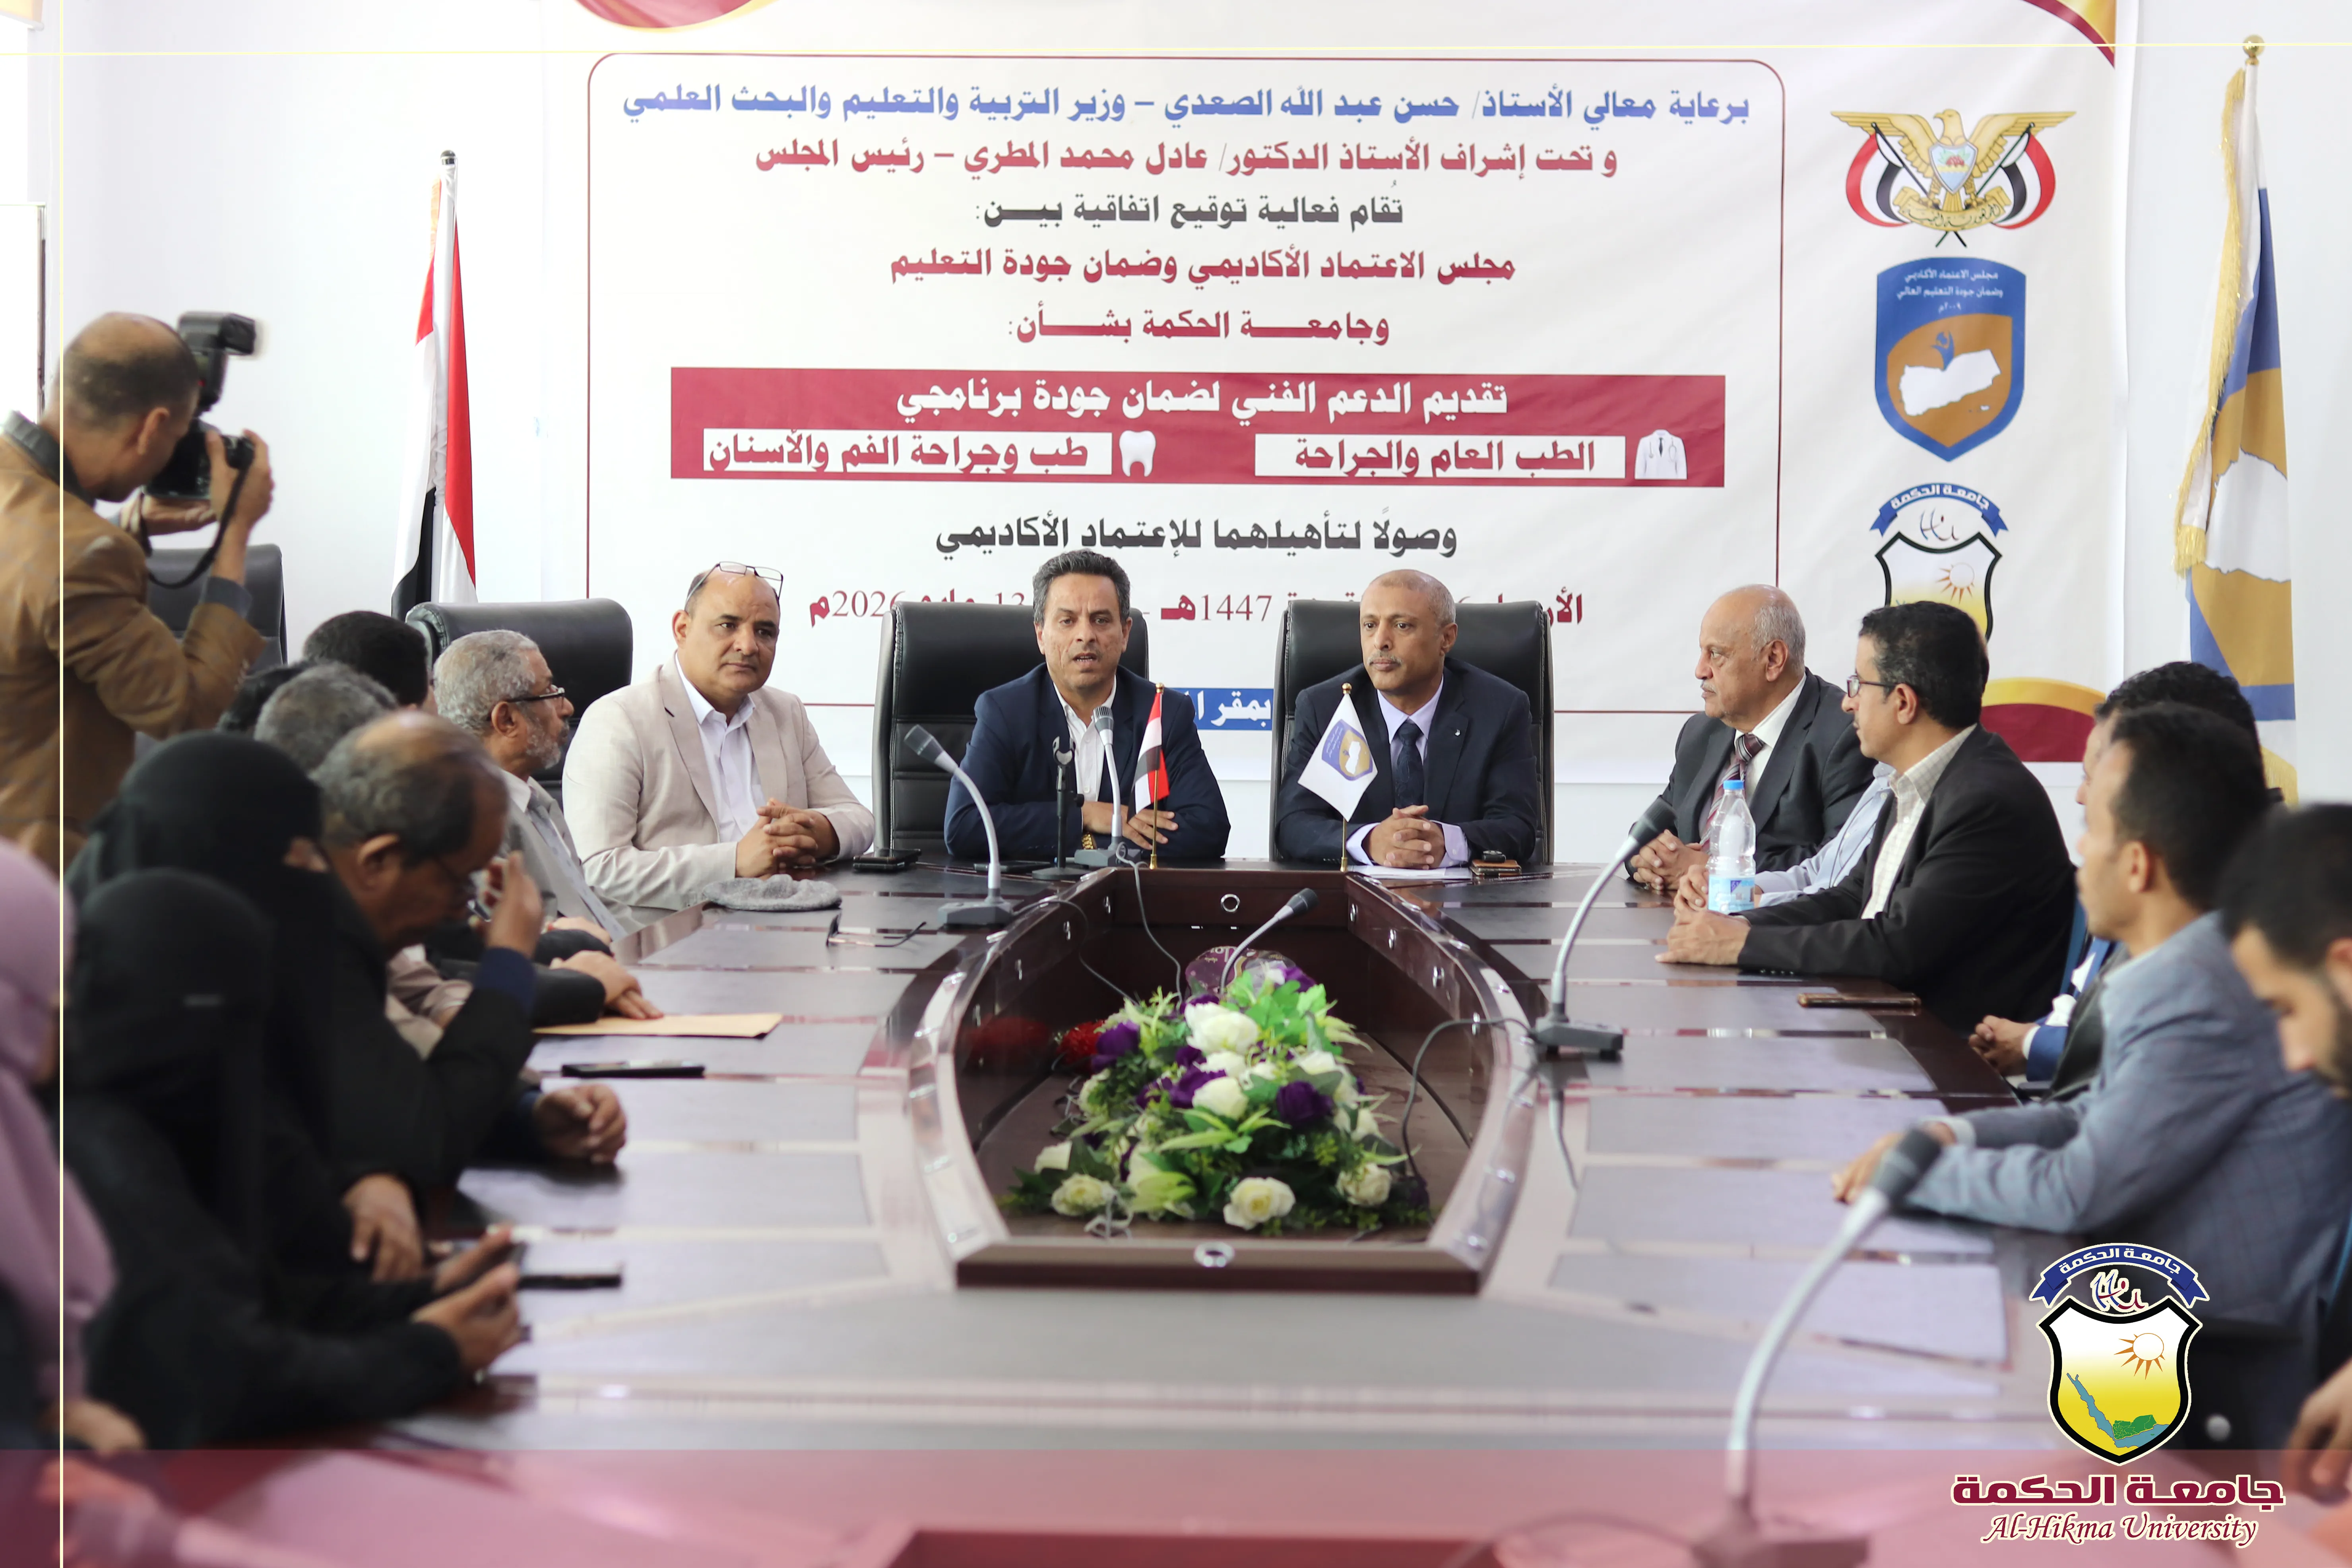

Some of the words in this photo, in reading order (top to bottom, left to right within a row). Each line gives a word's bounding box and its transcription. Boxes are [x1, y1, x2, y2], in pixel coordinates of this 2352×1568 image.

[623, 84, 721, 123] العلمي
[732, 85, 831, 119] والبحث
[843, 86, 959, 122] والتعليم
[969, 86, 1059, 121] التربية
[1067, 88, 1125, 122] وزير
[1164, 88, 1272, 129] الصعدي
[1280, 86, 1323, 117] الله
[1334, 94, 1383, 124] عبد
[1394, 96, 1460, 124] حسن
[1472, 83, 1573, 118] الأستاذ/
[1583, 90, 1657, 131] معالي
[1669, 90, 1749, 125] برعاية
[756, 138, 838, 172] المجلس
[851, 137, 924, 174] رئيس
[964, 140, 1049, 180] المطري
[1060, 146, 1134, 170] محمد
[1145, 141, 1208, 175] عادل
[1219, 141, 1328, 176] الدكتور/
[1339, 136, 1429, 171] الأستاذ
[1440, 142, 1525, 180] إشراف
[1073, 194, 1159, 228] اتفاقية
[1170, 195, 1247, 229] توقيع
[1258, 195, 1339, 230] فعالية
[891, 247, 991, 284] التعليم
[1002, 248, 1072, 283] جودة
[1083, 248, 1177, 284] وضمان
[1188, 243, 1309, 291] الأكاديمي
[1320, 250, 1425, 280] الاعتماد
[1437, 252, 1516, 285] مجلس
[1970, 270, 1998, 282] مجلس
[1142, 309, 1229, 339] الحكمة
[897, 378, 1021, 424] برنامجي
[1033, 380, 1110, 418] جودة
[1123, 380, 1220, 422] لضمان
[1232, 381, 1316, 426] الفني
[1328, 382, 1411, 423] الدعم
[1423, 382, 1507, 424] تقديم
[710, 428, 828, 471] والأسنان
[842, 434, 898, 473] الفم
[911, 434, 1018, 474] وجراحة
[1030, 436, 1088, 475] طب
[1296, 439, 1419, 477] والجراحة
[1431, 441, 1503, 477] العام
[1516, 441, 1594, 478] الطب
[1891, 484, 1940, 510] الحكمة
[1943, 484, 1990, 510] جامعة
[936, 510, 1069, 561] الأكاديمي
[1081, 518, 1202, 558] للإعتماد
[1214, 510, 1361, 557] لتأهيلهما
[1211, 691, 1271, 727] بمقر
